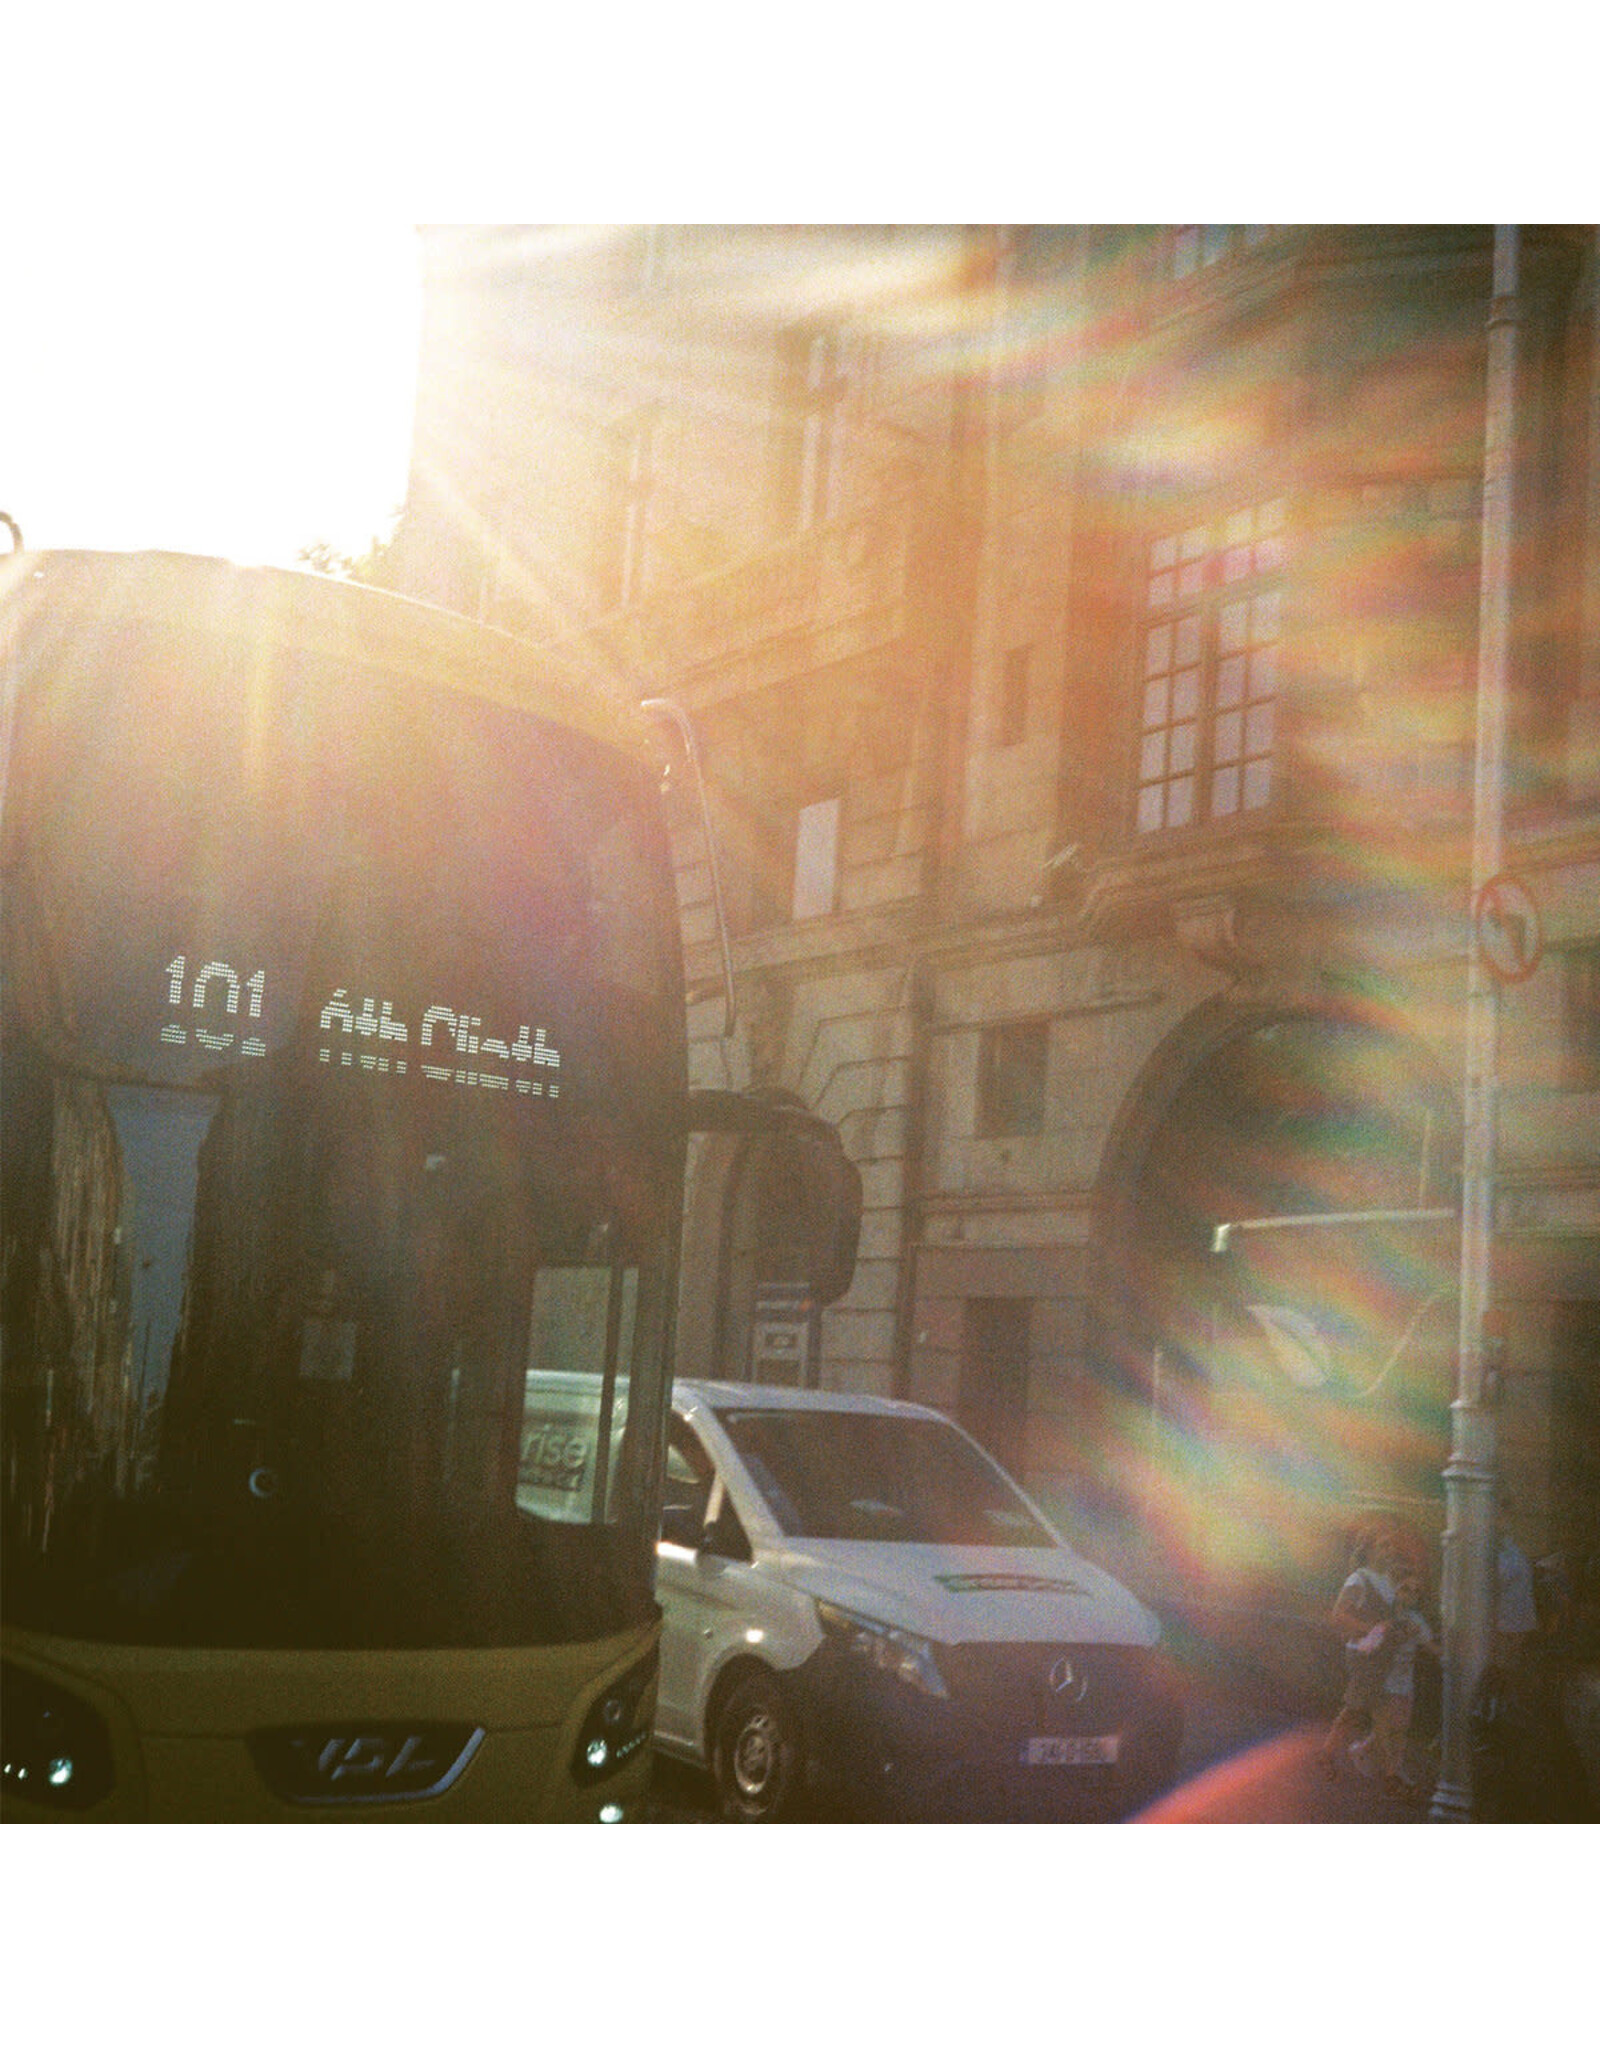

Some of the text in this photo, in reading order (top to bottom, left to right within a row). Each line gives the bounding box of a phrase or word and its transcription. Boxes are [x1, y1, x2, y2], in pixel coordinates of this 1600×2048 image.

[160, 955, 562, 1099] 101 Áth Cliath
